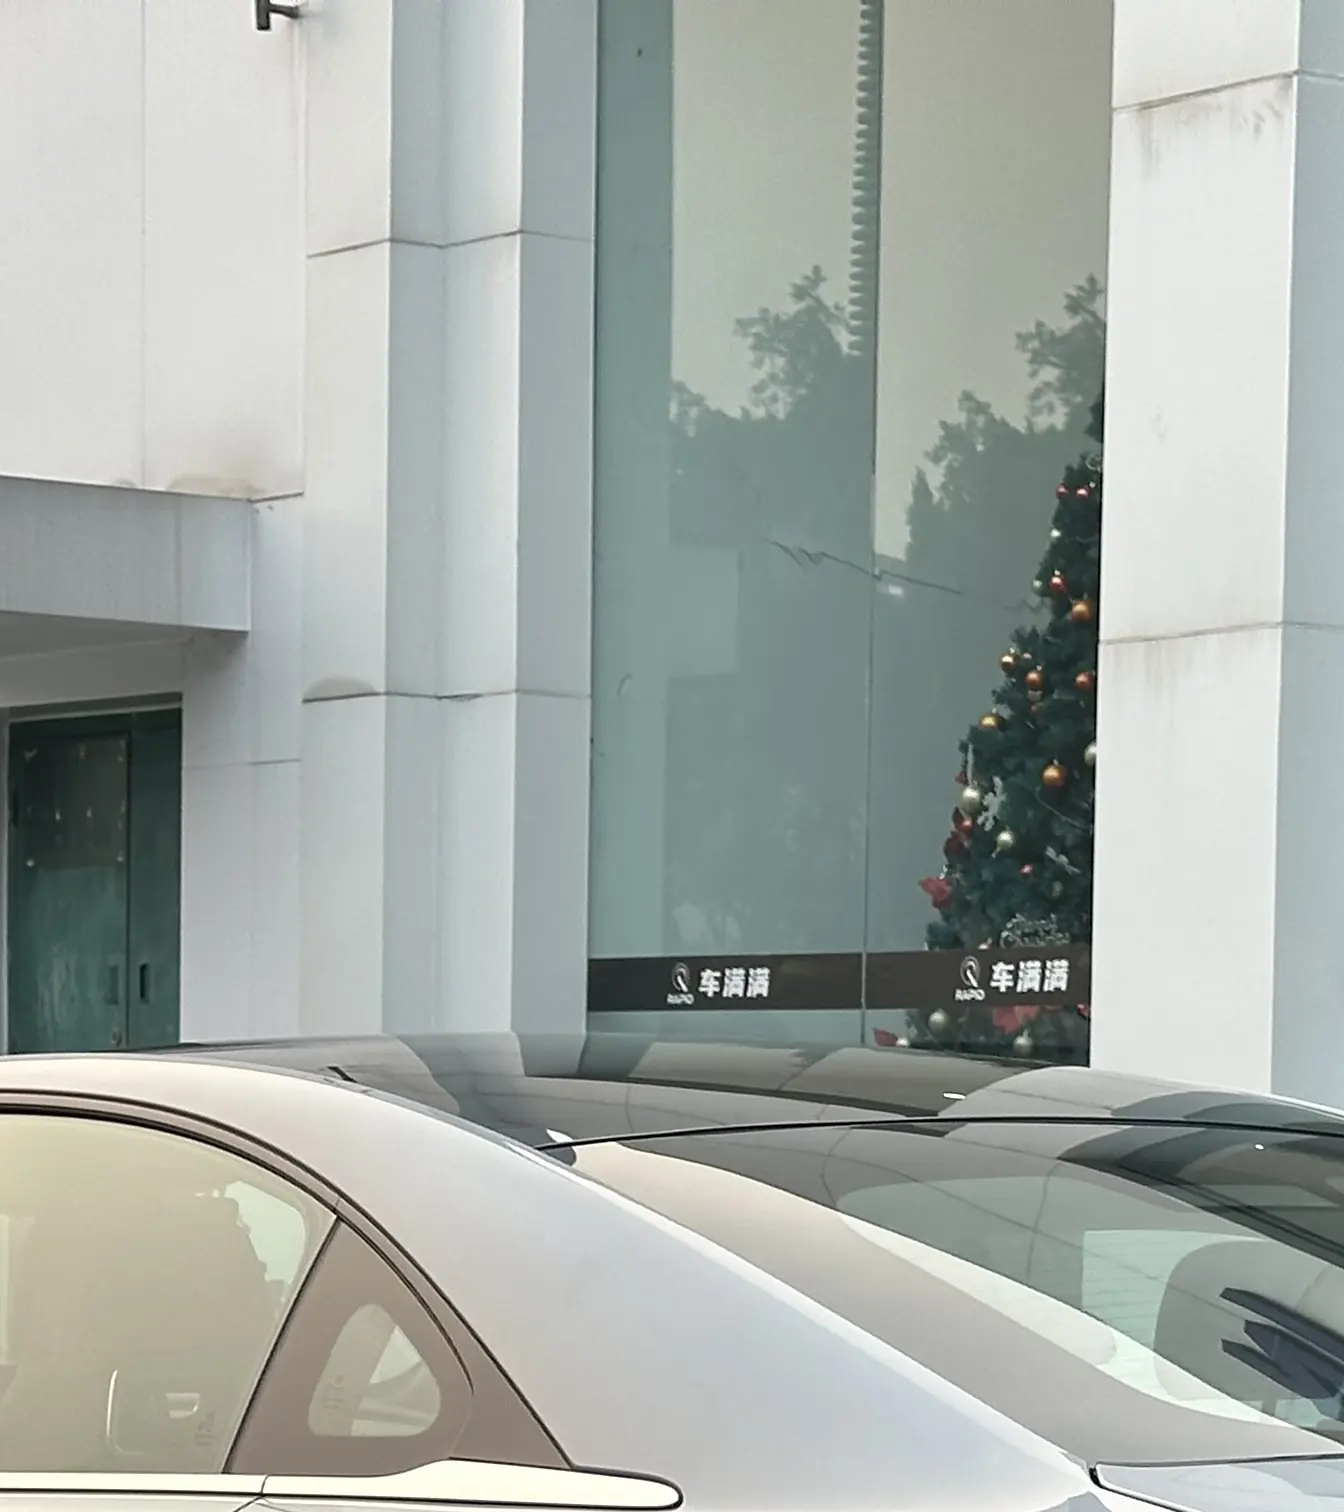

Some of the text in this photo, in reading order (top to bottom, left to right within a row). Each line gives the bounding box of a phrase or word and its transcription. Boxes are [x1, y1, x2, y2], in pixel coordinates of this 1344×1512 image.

[698, 967, 770, 998] 车满满
[990, 959, 1070, 992] 车满满
